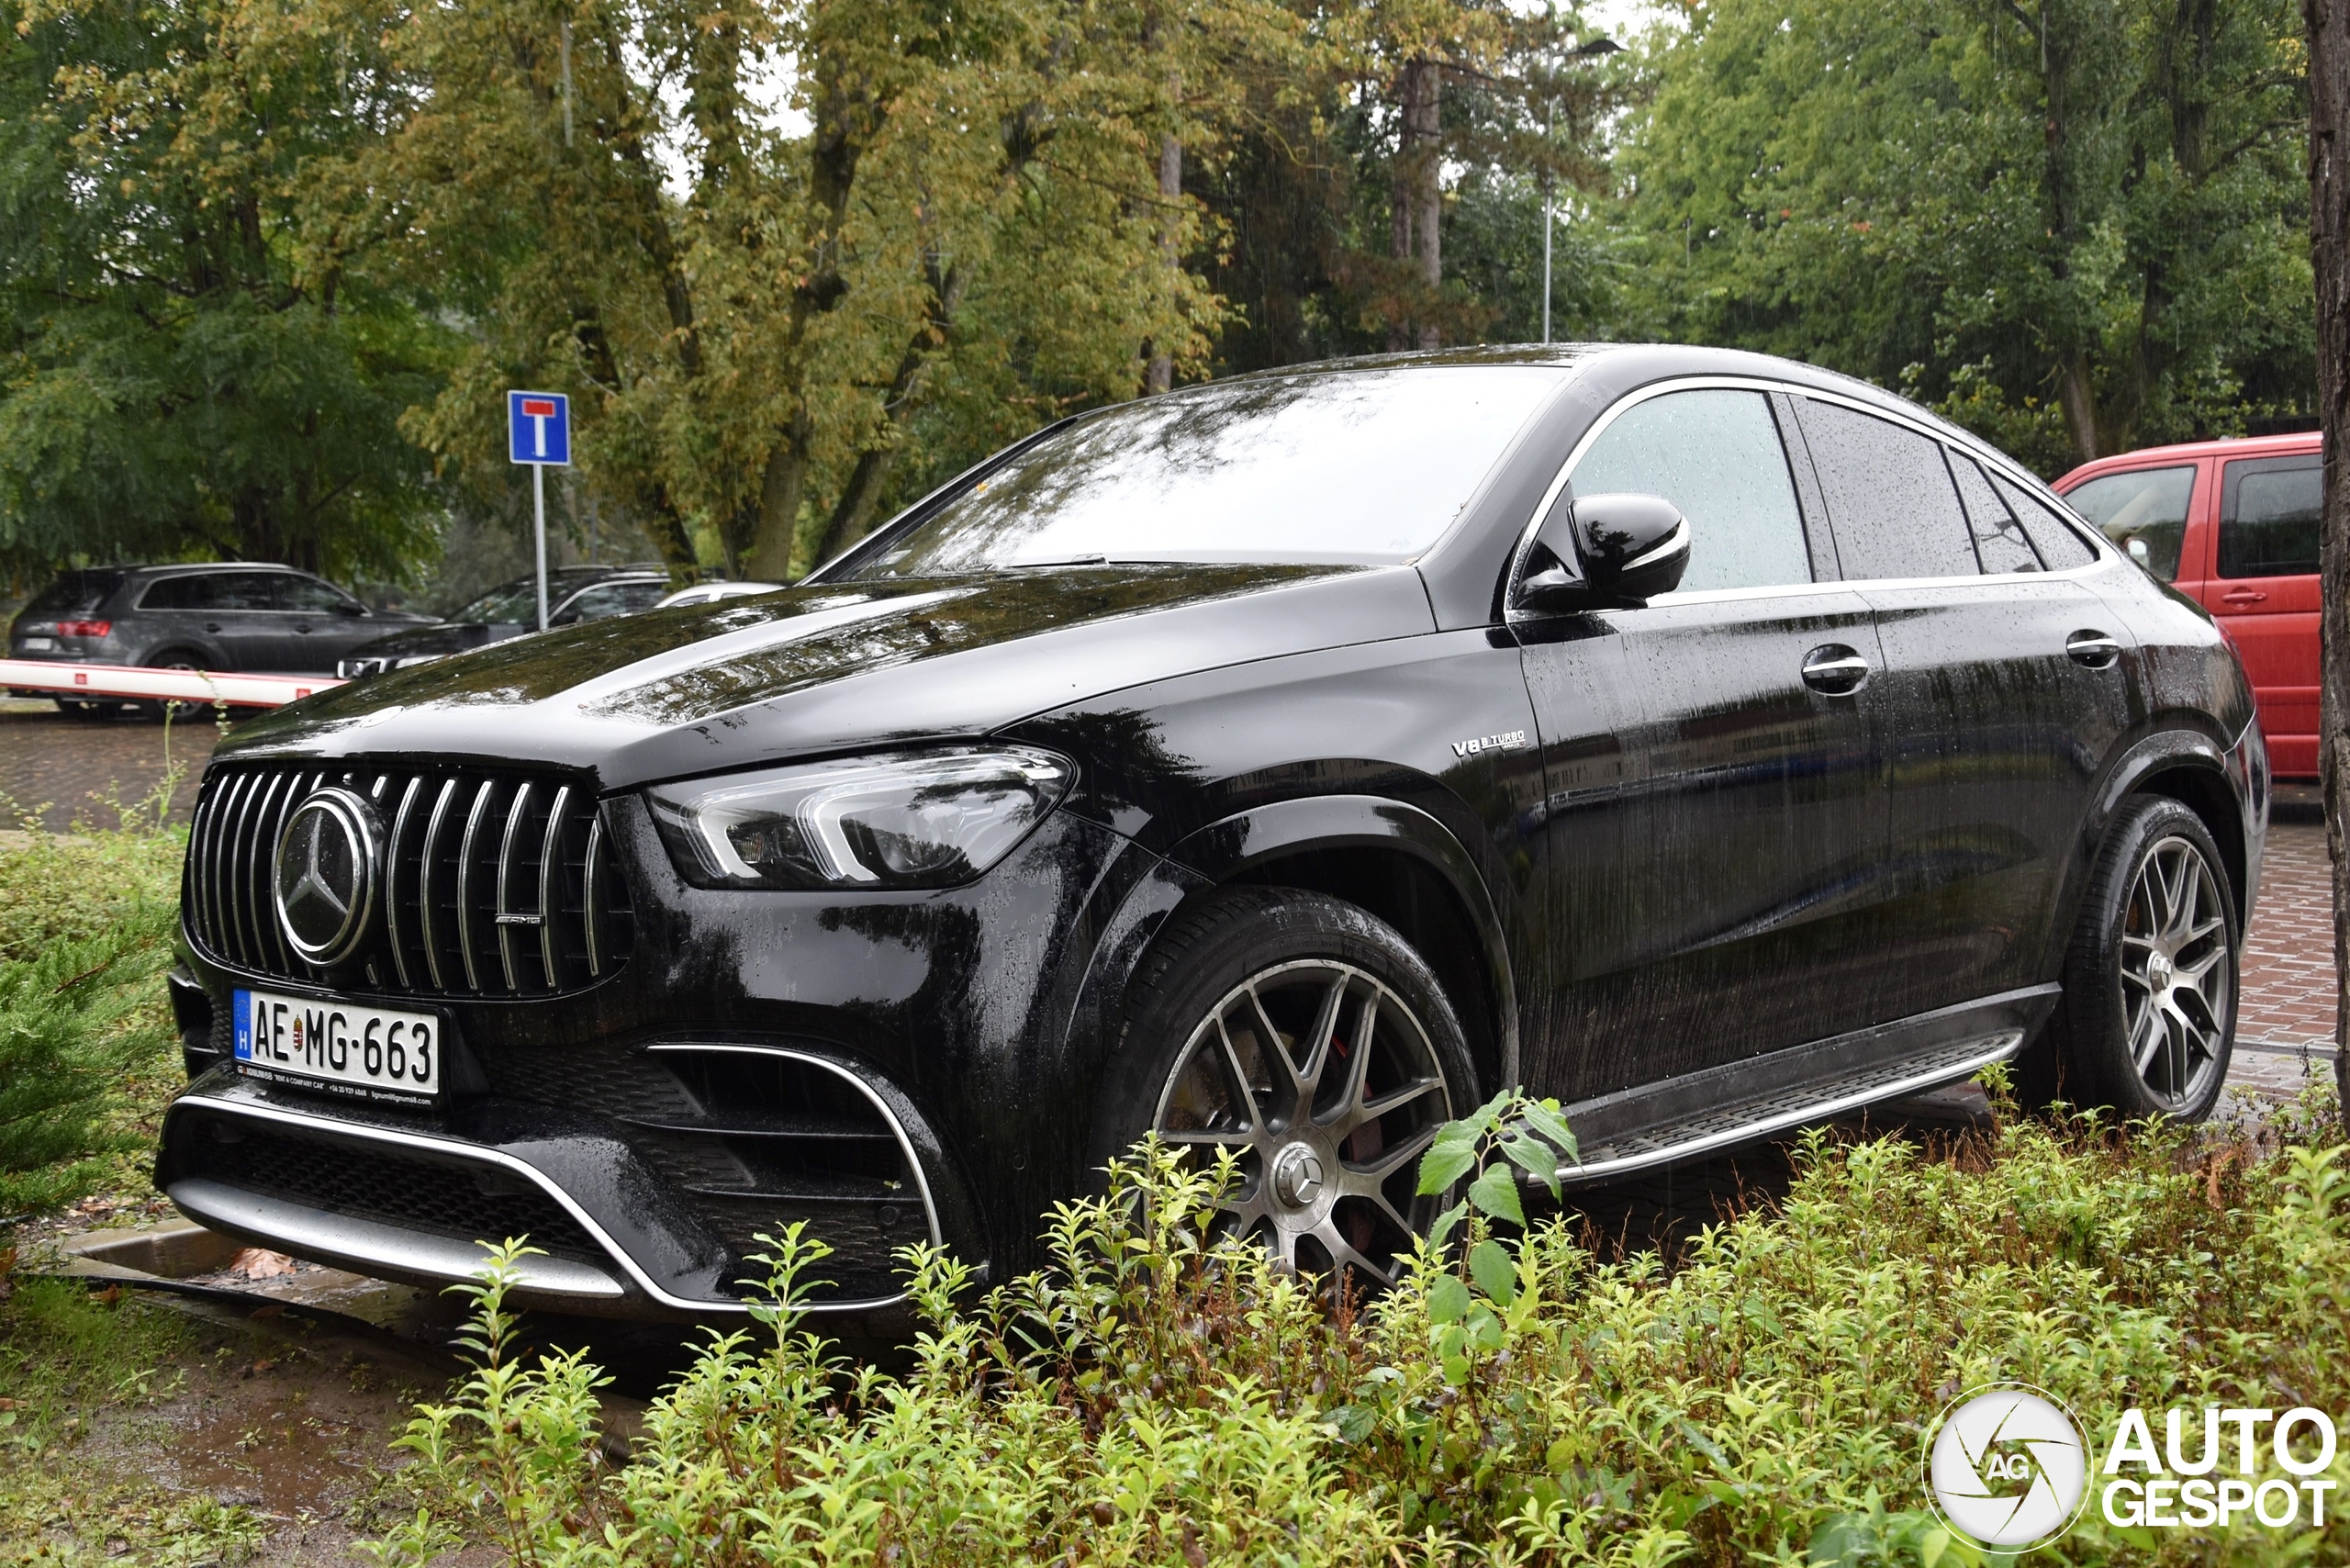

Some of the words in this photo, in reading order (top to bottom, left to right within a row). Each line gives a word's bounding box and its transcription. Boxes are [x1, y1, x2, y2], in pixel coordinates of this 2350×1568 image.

[1480, 729, 1525, 745] BTURBO
[1451, 739, 1481, 756] V8
[509, 916, 541, 924] AMG
[255, 999, 289, 1061] AE
[239, 1030, 249, 1050] H
